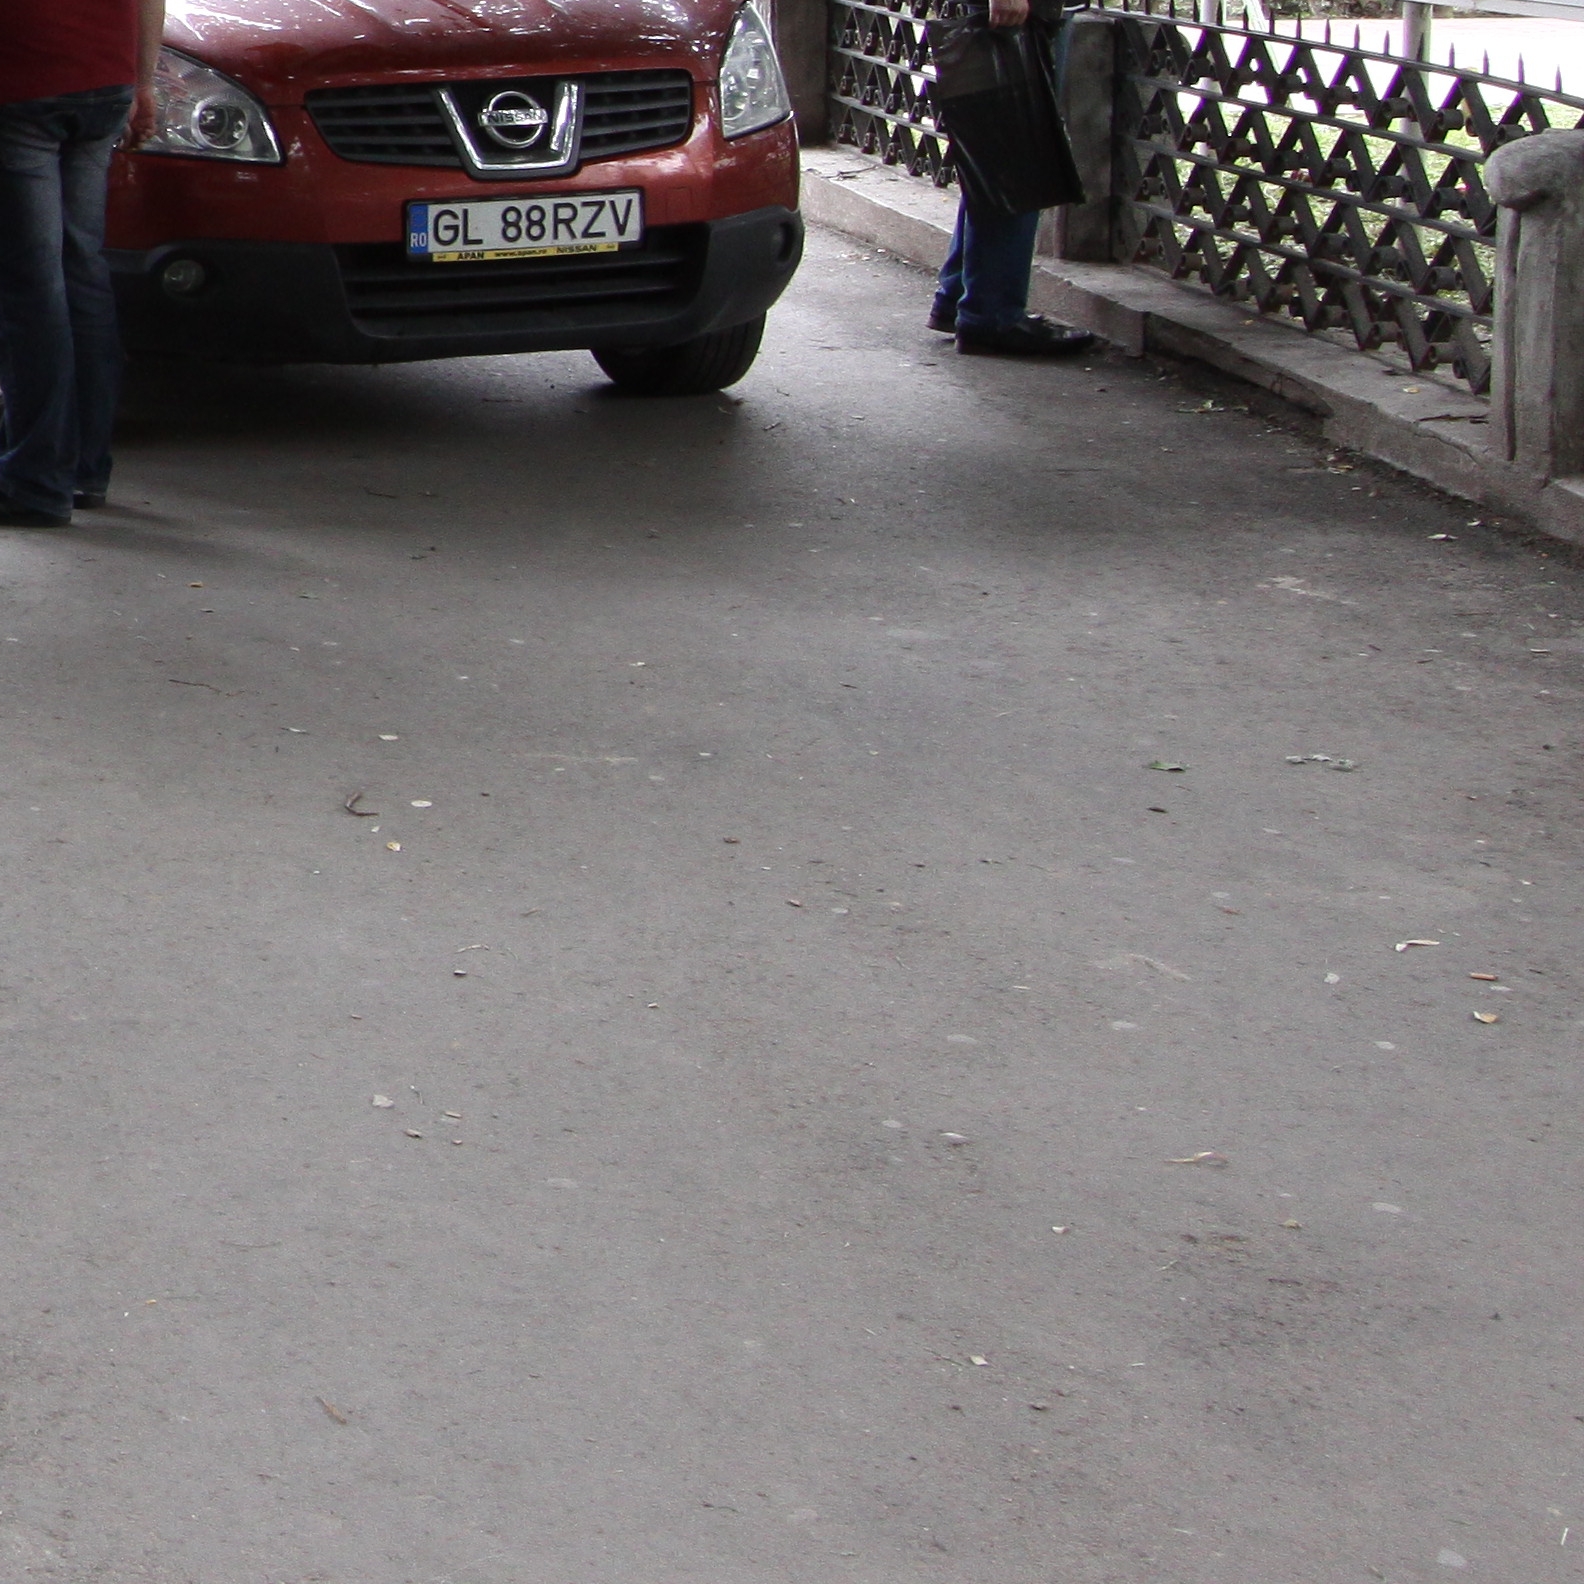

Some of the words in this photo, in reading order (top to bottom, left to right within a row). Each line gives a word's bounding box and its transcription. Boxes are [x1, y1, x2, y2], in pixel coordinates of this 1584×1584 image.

[487, 111, 541, 123] NISSAN
[433, 208, 483, 246] GL
[501, 198, 633, 243] 88RZV
[410, 232, 426, 248] RO
[458, 251, 484, 260] APAN
[556, 244, 597, 254] NISSAN
